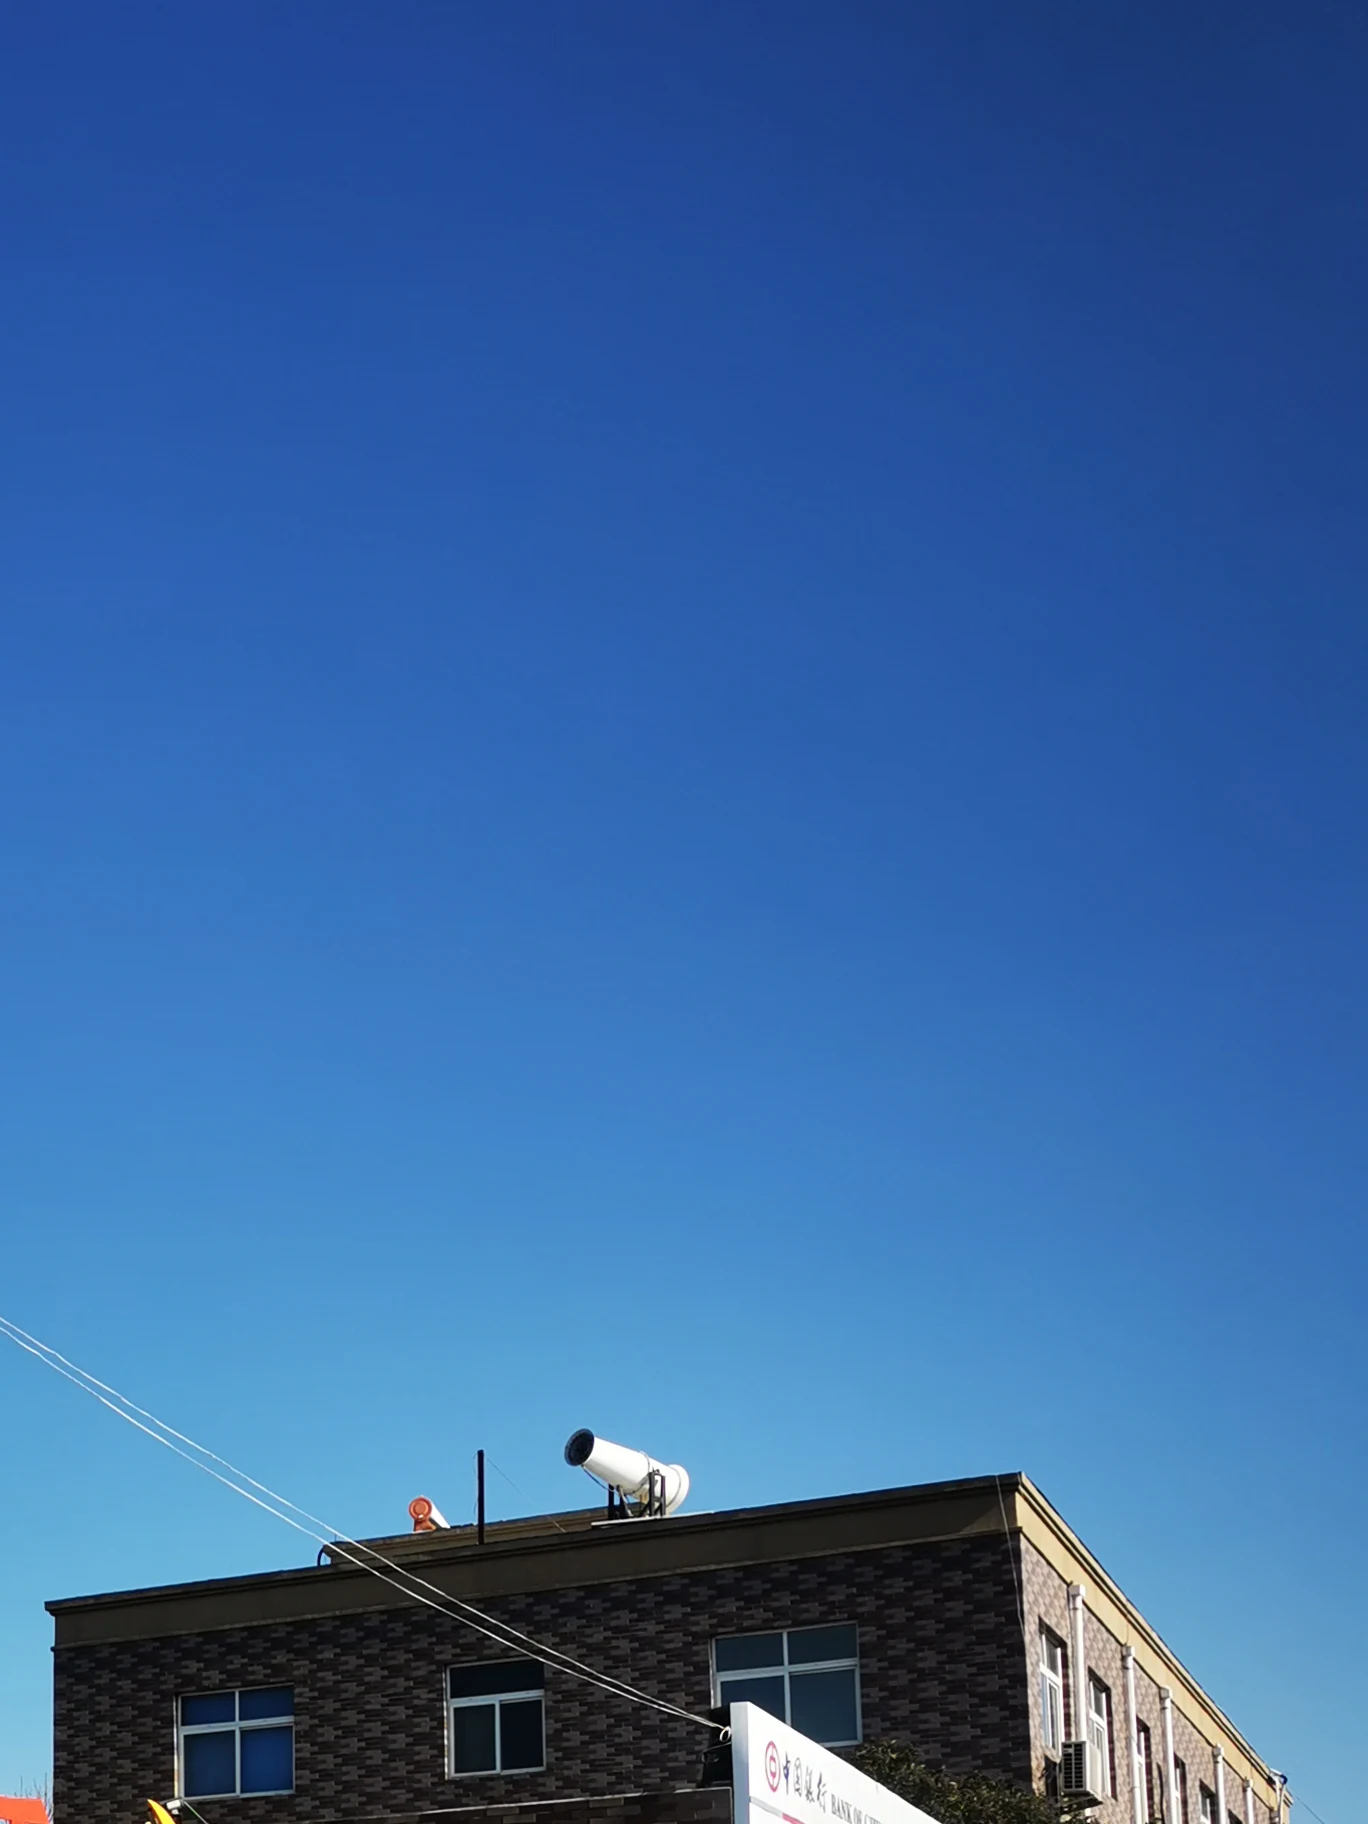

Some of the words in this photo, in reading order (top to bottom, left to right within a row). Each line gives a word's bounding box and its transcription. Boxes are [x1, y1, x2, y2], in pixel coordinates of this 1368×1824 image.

[782, 1751, 828, 1813] 中国银行
[831, 1793, 853, 1824] BANK
